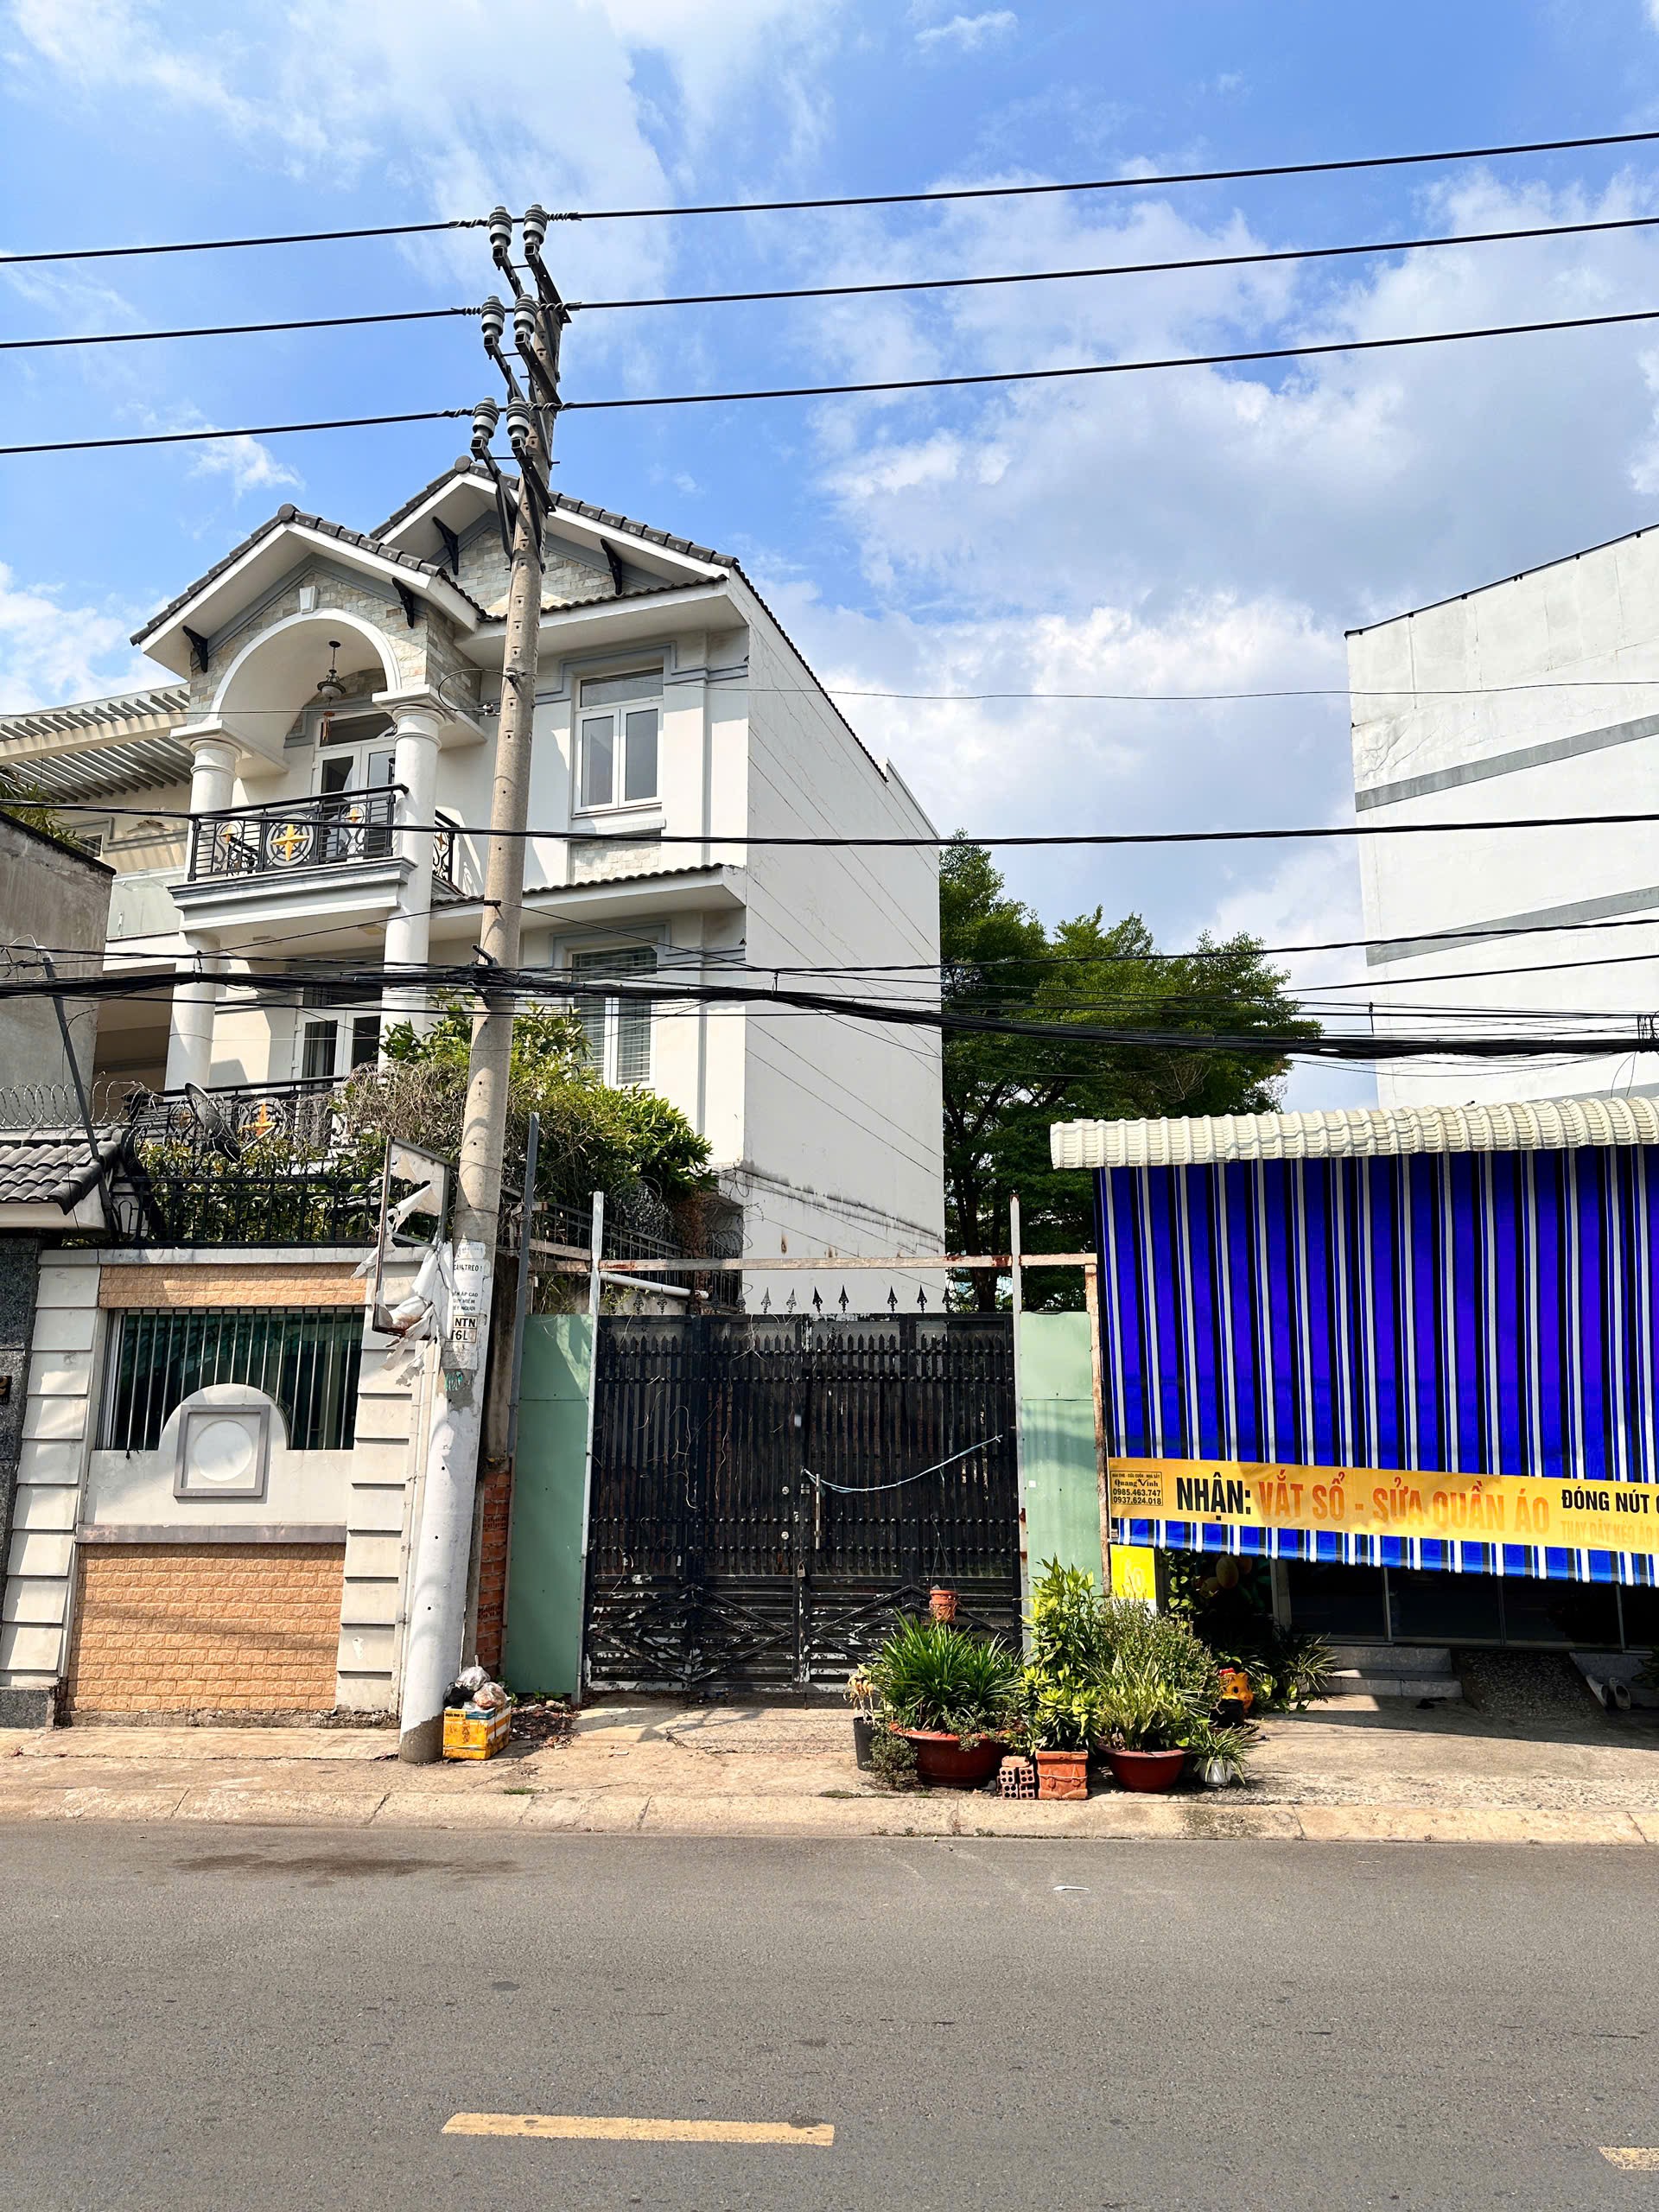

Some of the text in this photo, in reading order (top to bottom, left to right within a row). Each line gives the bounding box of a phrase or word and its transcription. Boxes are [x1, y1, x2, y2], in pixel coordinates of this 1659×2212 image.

[454, 1318, 476, 1328] NTN
[1115, 1478, 1159, 1487] Quang Vinh
[1113, 1488, 1161, 1497] 0985.463.747
[1113, 1496, 1162, 1505] 0937.624.018
[1176, 1471, 1251, 1521] NHẬN:
[1258, 1469, 1304, 1518] VẮT
[1312, 1471, 1345, 1521] SỔ
[1372, 1476, 1425, 1527] SỬA
[1433, 1480, 1505, 1533] QUẦN
[1514, 1488, 1550, 1535] ÁO
[1561, 1485, 1610, 1511] ĐÓNG
[1615, 1489, 1650, 1514] NÚT
